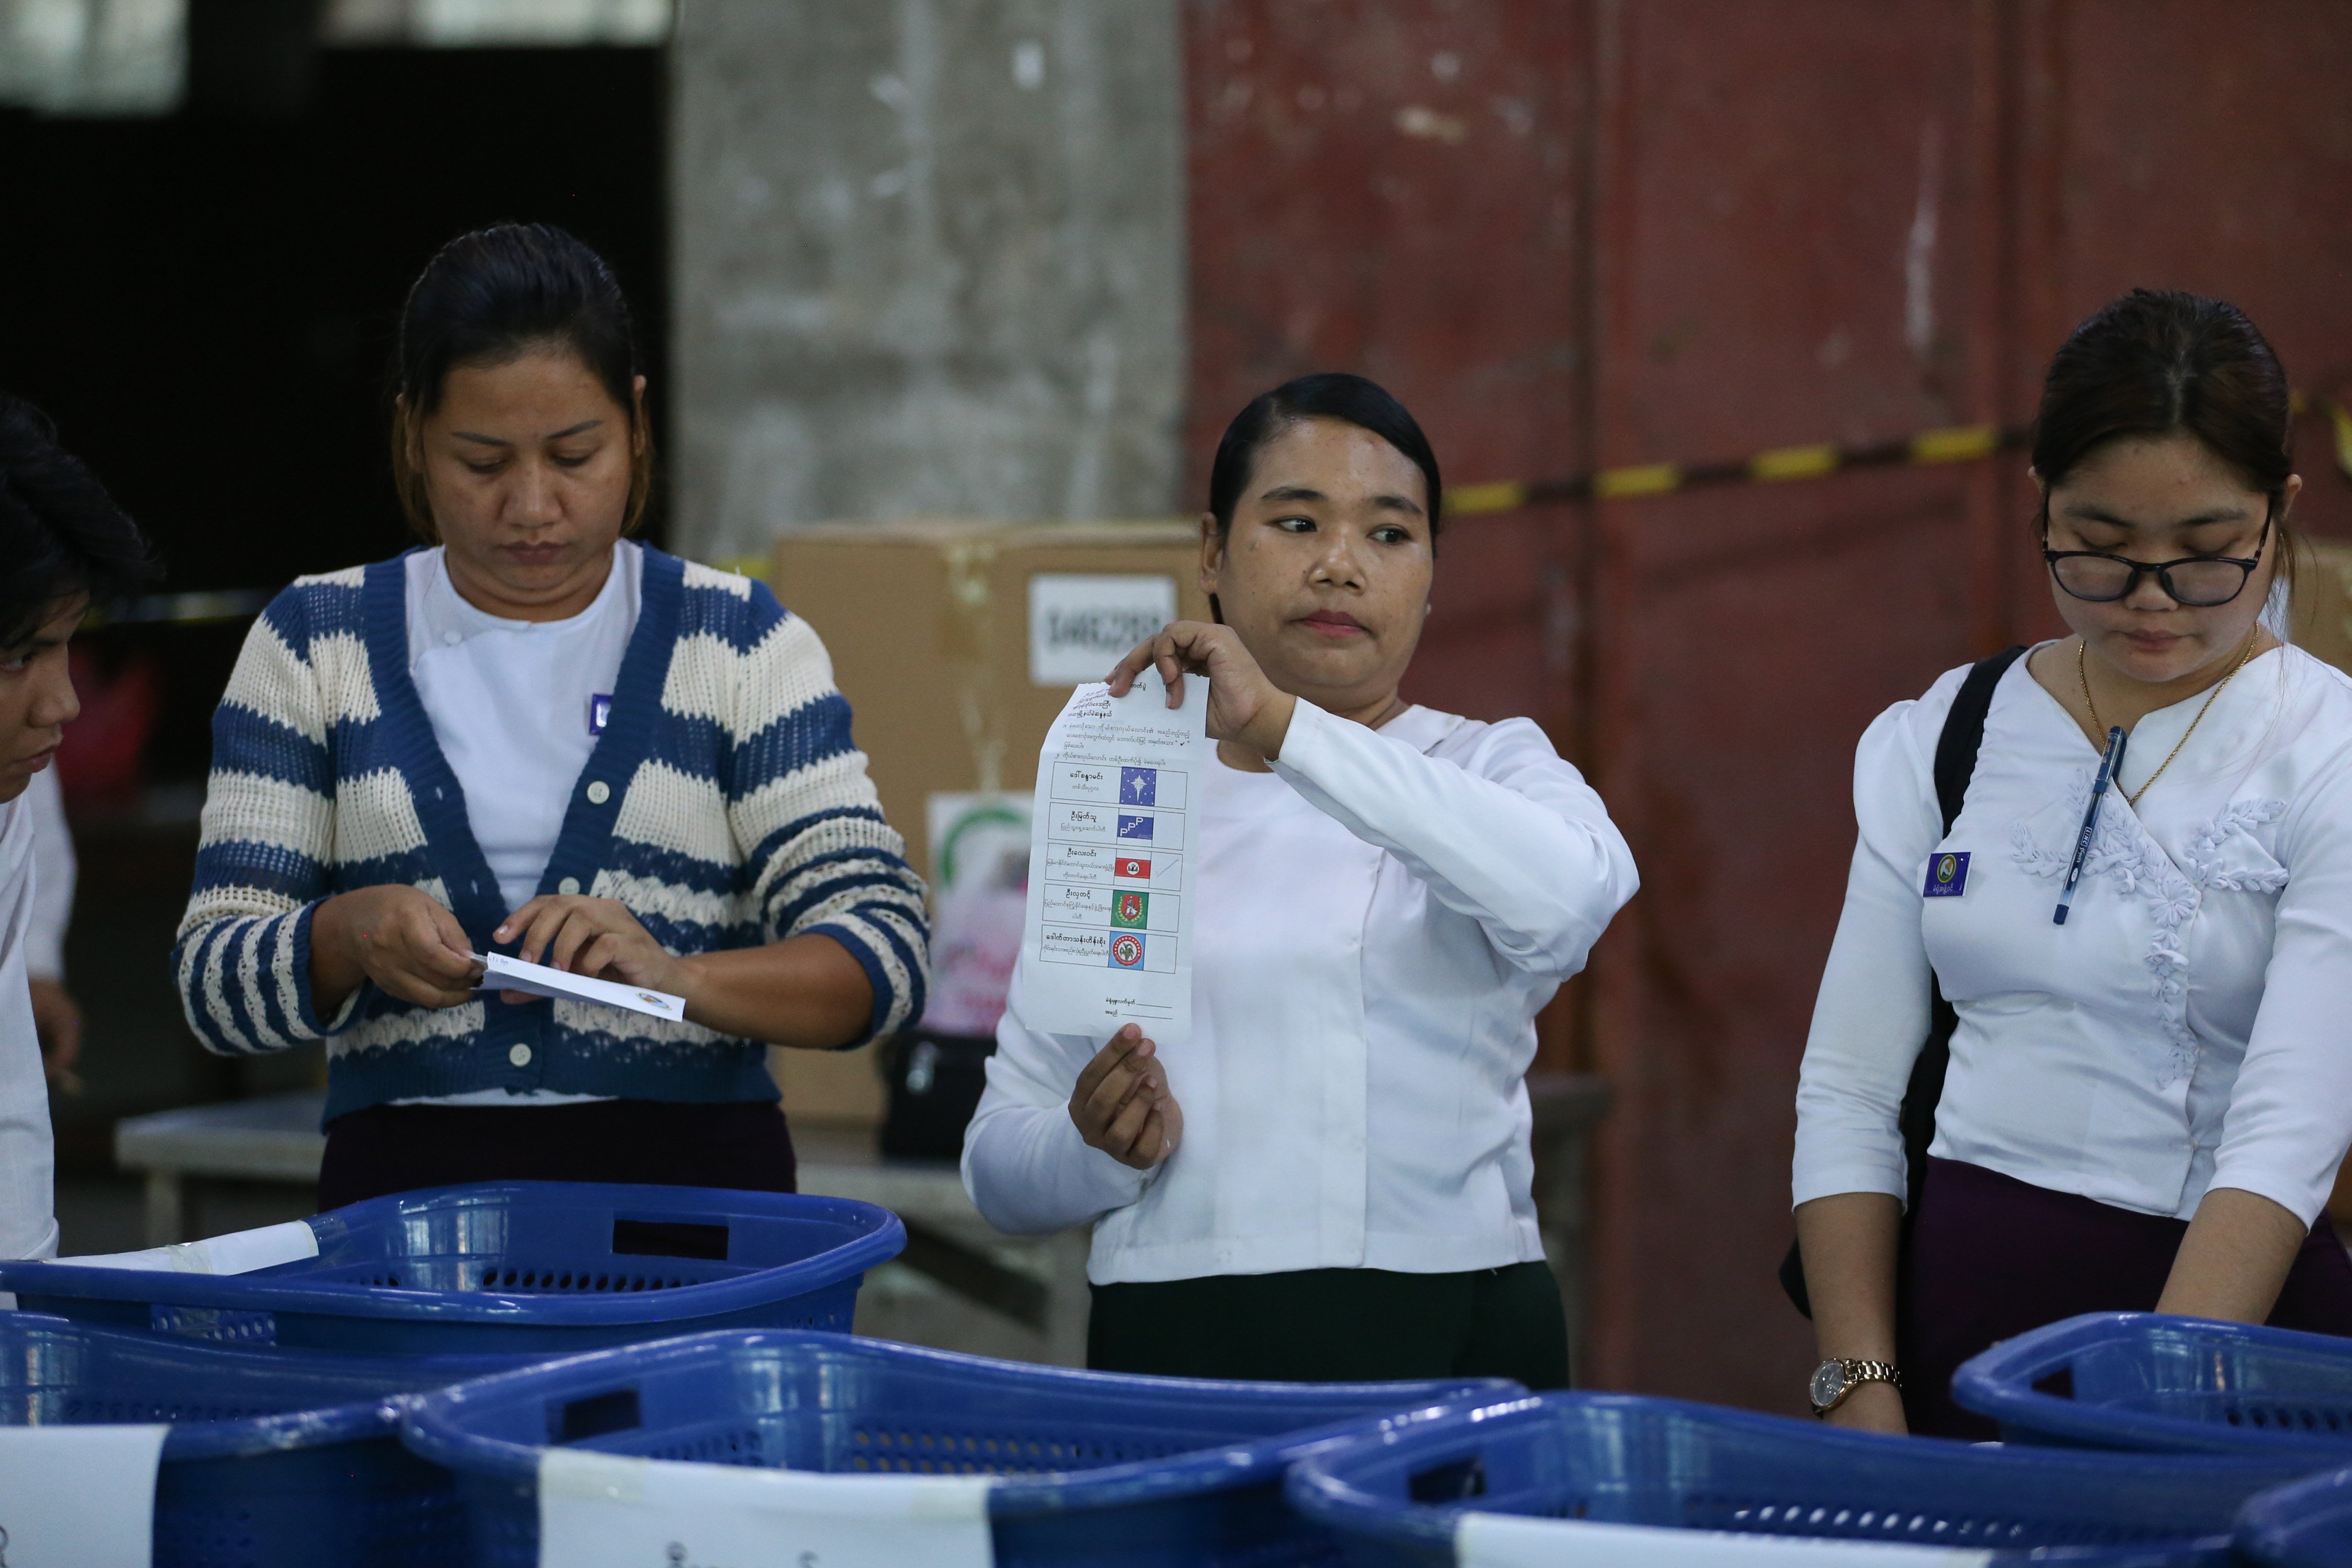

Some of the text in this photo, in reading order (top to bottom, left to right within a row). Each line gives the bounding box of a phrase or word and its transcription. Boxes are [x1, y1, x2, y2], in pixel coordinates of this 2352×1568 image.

[2081, 828, 2091, 845] LINC
[1067, 847, 1097, 858] ဦးလေးဝင်း
